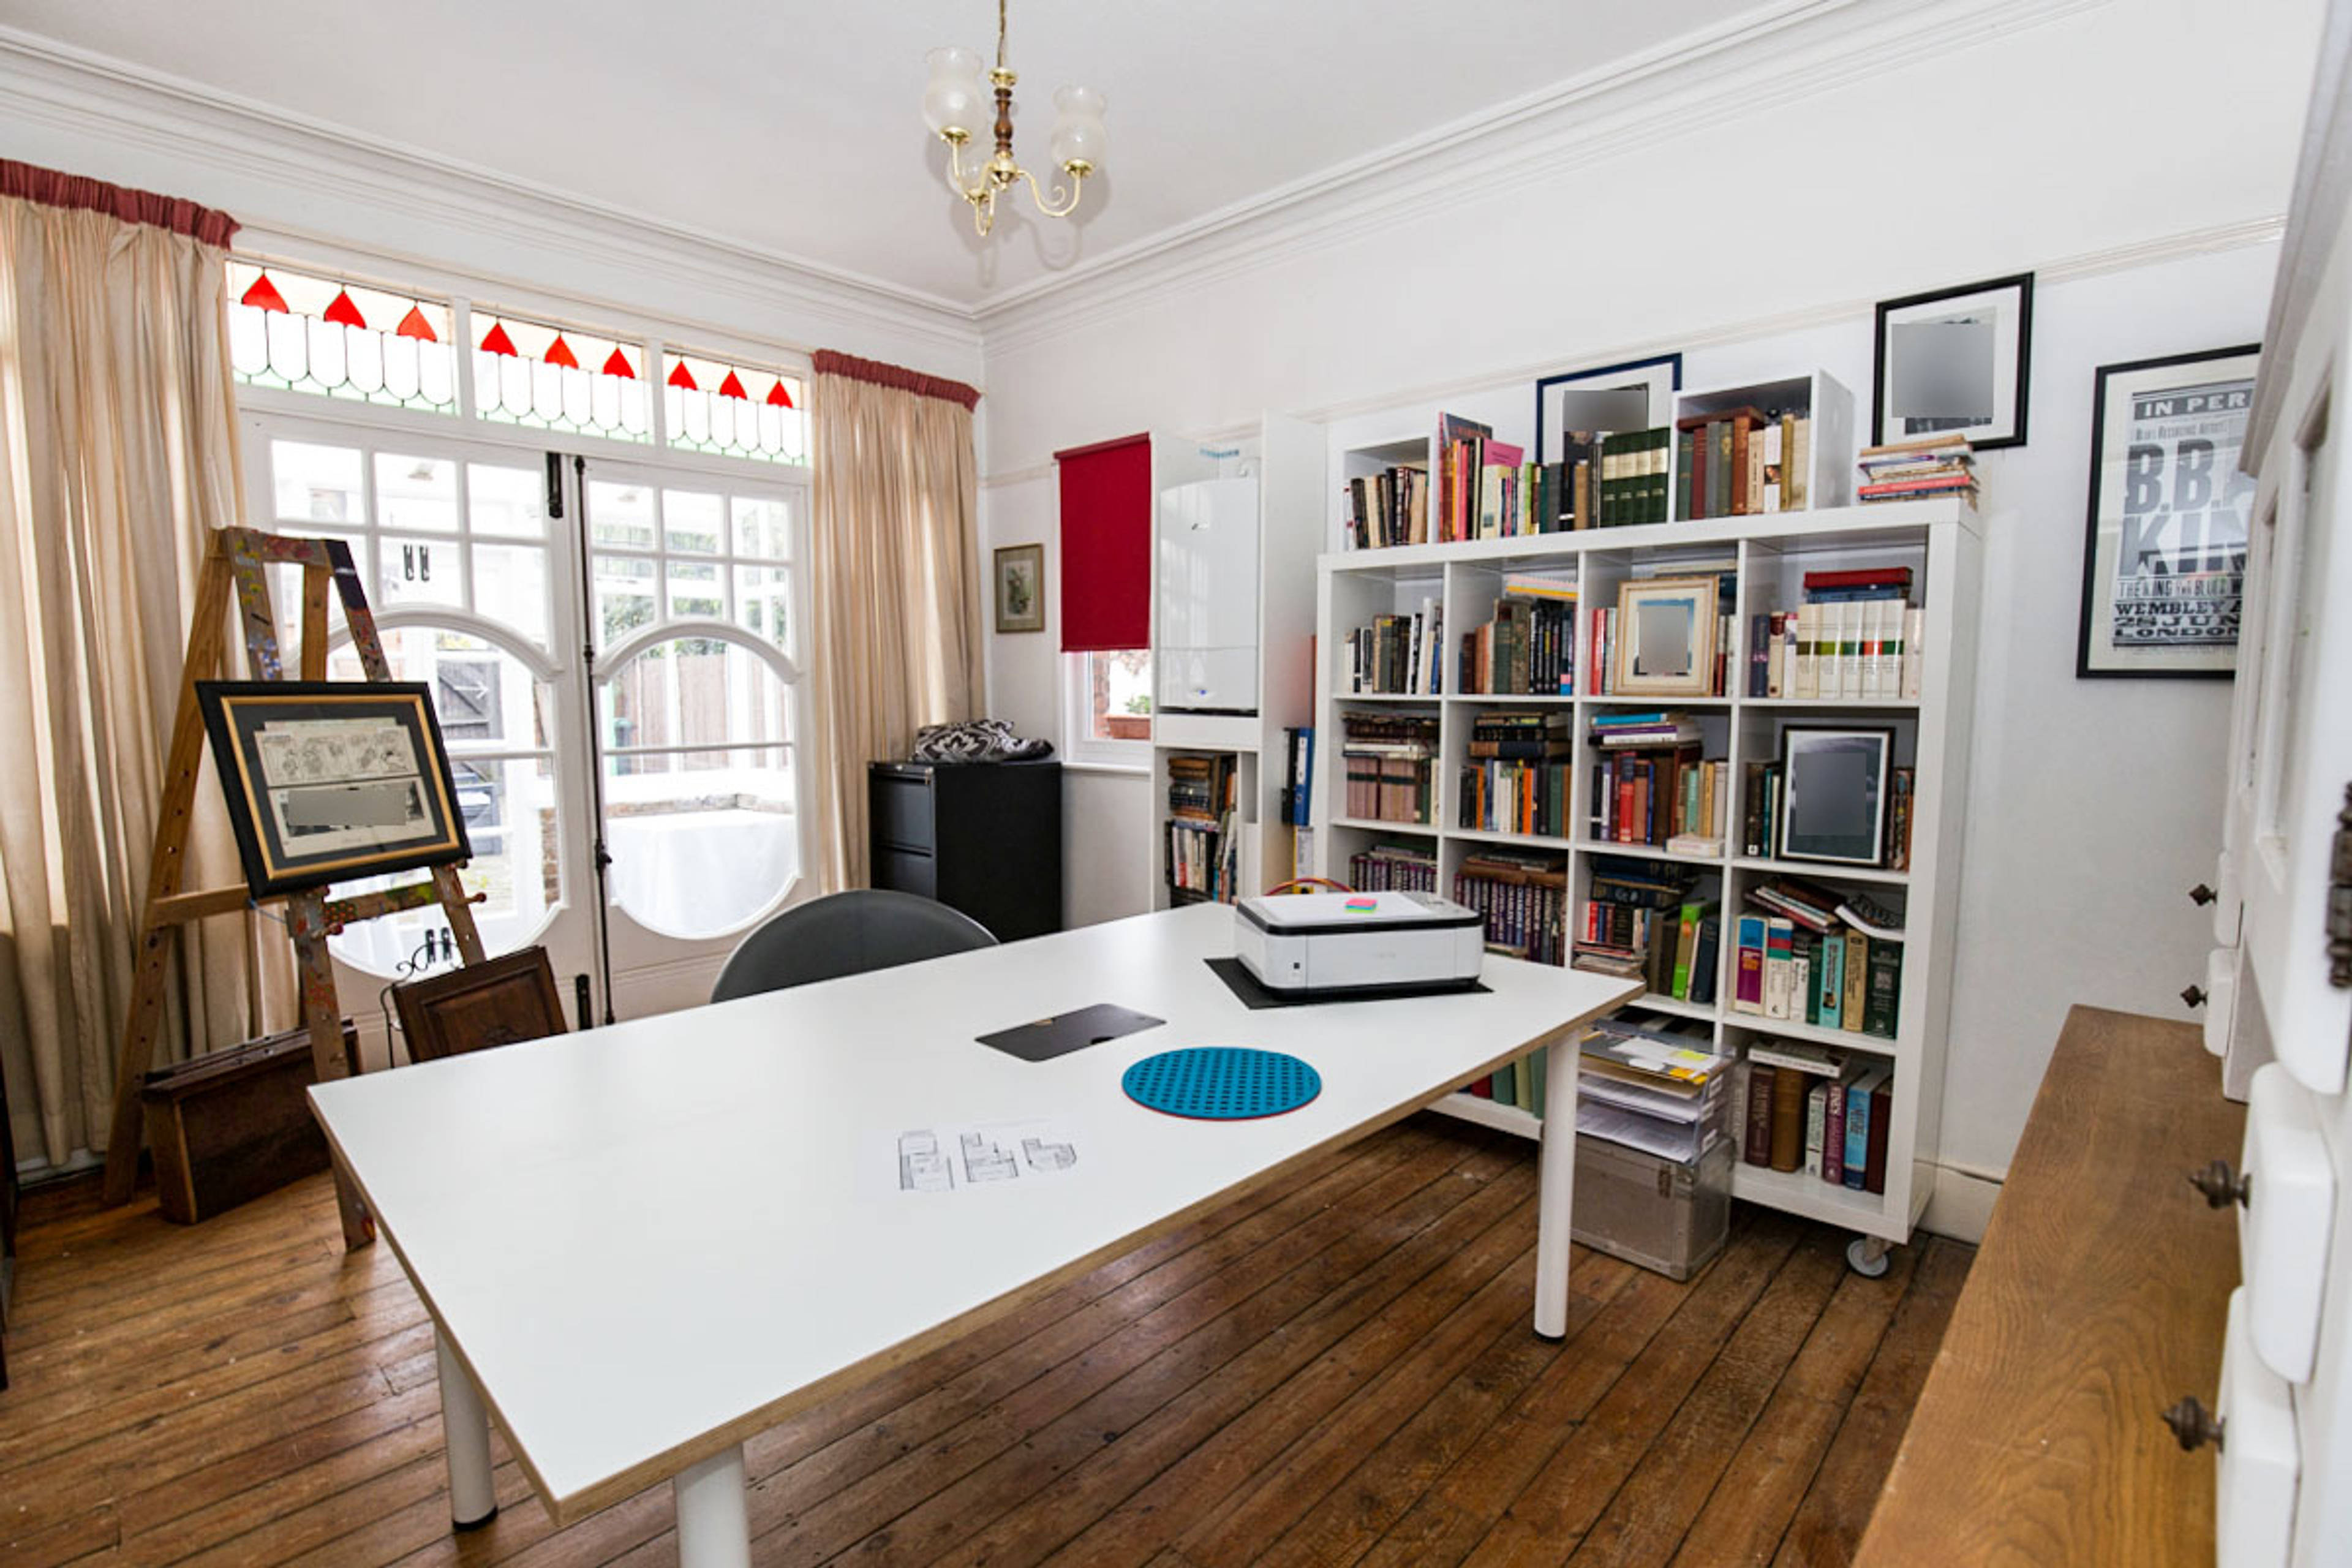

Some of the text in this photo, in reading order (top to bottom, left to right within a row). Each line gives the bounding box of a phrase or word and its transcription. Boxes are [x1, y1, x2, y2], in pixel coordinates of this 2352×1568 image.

[2145, 391, 2247, 417] IN PER
[2119, 510, 2247, 576] KIN
[2115, 600, 2226, 615] WEMBLEY
[2162, 614, 2241, 627] JUN
